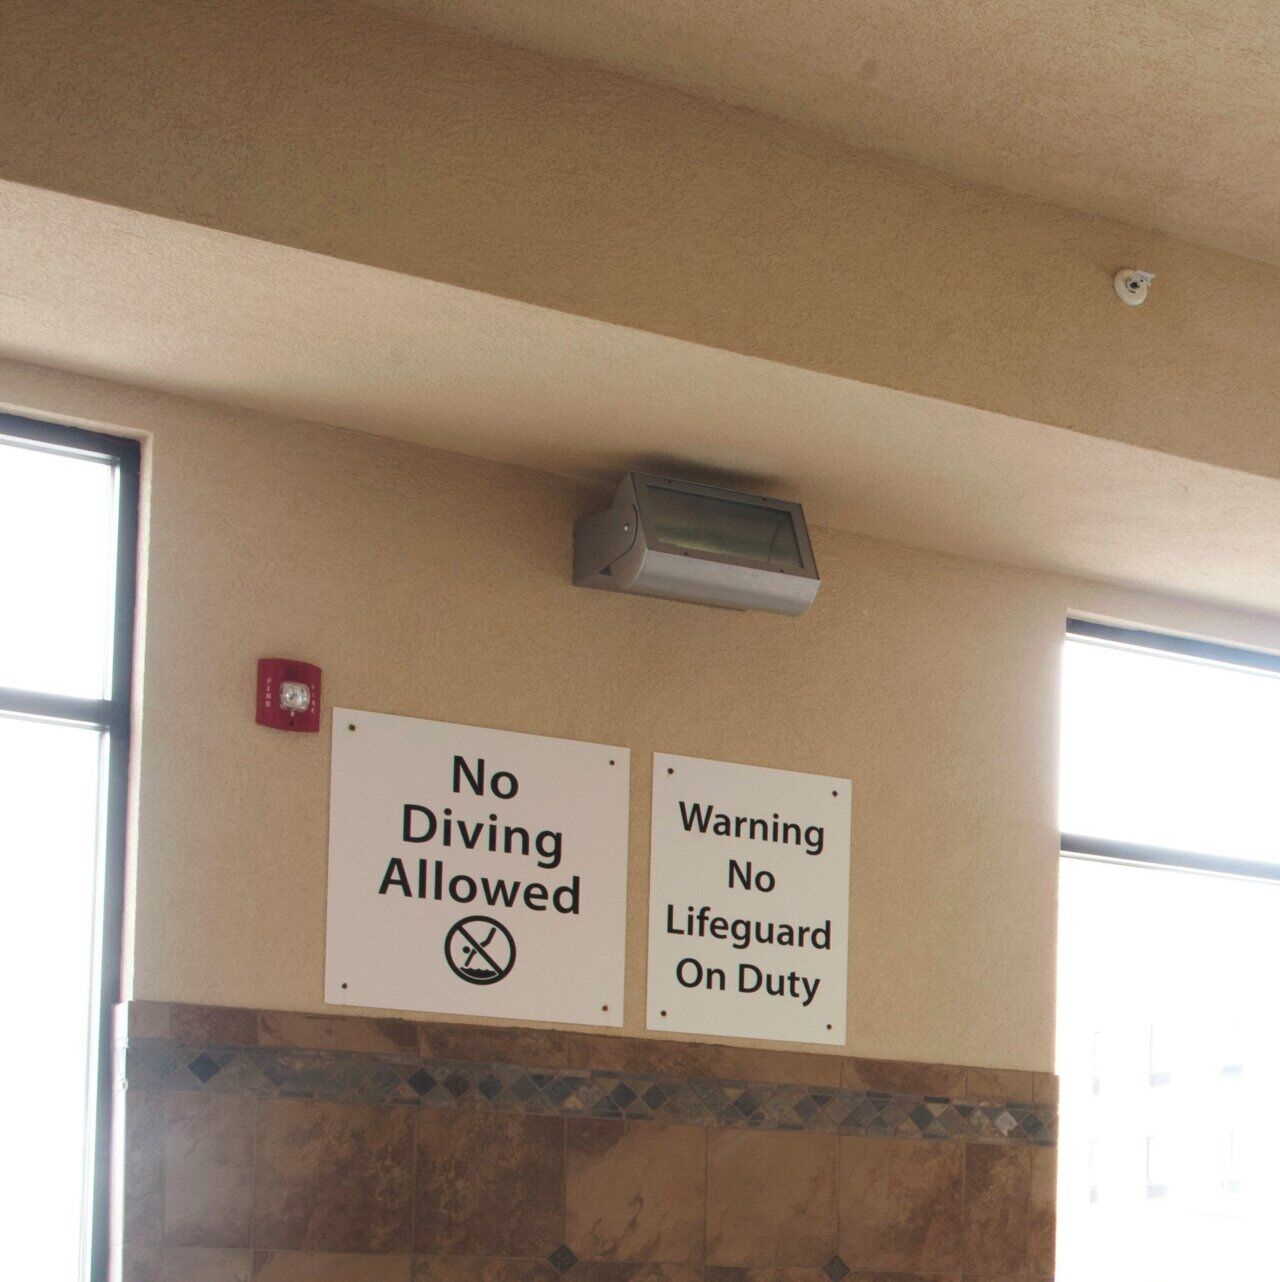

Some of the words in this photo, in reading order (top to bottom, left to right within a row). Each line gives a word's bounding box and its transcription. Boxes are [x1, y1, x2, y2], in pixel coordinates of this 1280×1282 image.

[453, 755, 519, 800] No
[403, 804, 562, 869] Diving
[678, 801, 824, 856] Warning
[378, 857, 580, 914] Allowed
[728, 859, 776, 893] No
[667, 904, 831, 950] Lifeguard
[676, 958, 726, 991] On
[738, 964, 821, 1007] Duty
